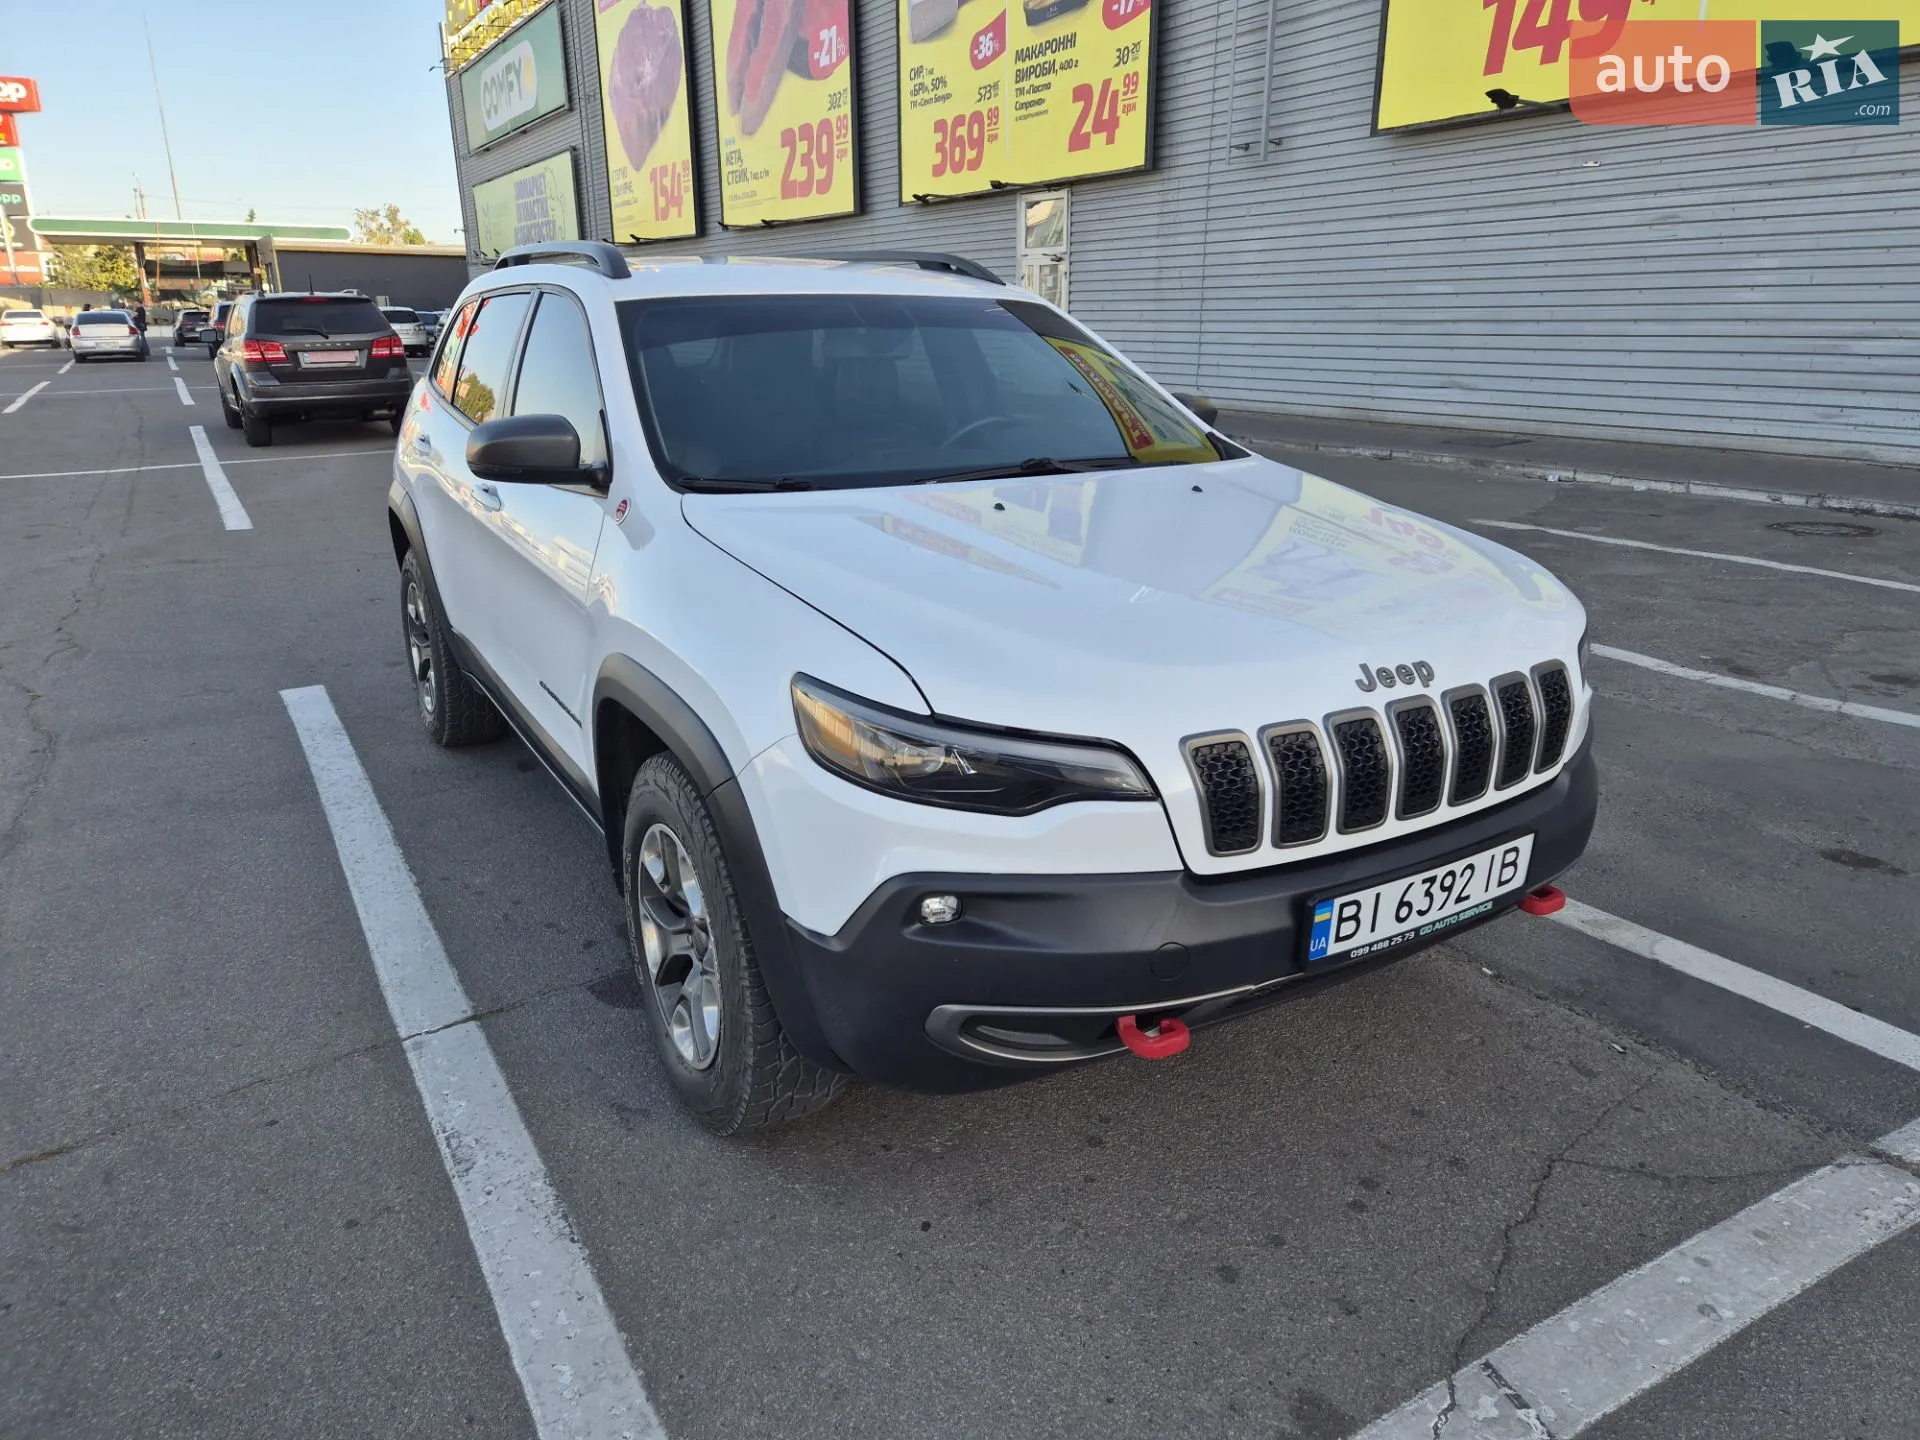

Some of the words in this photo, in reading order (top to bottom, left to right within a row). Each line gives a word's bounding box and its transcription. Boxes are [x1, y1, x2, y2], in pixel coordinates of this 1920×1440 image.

[813, 24, 846, 67] -21%
[1014, 32, 1077, 64] МАКАРОННІ
[1113, 45, 1130, 68] 30
[1482, 0, 1632, 76] 149
[483, 56, 522, 120] COMFY
[909, 65, 924, 81] СИР,
[931, 75, 948, 92] 50%
[1014, 58, 1058, 84] ВИРОБИ,
[1059, 58, 1073, 72] 400
[1068, 77, 1120, 152] 24
[1121, 71, 1139, 96] 99
[1121, 102, 1136, 116] грн
[780, 117, 835, 201] 239
[835, 112, 849, 140] 99
[931, 110, 985, 178] 369
[986, 106, 999, 127] 99
[649, 162, 684, 222] 154
[1355, 660, 1435, 693] Jeep
[1334, 892, 1381, 944] BI
[1394, 862, 1475, 924] 6392
[1484, 846, 1520, 893] IB
[1310, 936, 1327, 951] UA
[1350, 946, 1369, 958] 099
[1370, 939, 1389, 952] 488
[1403, 931, 1415, 942] 73
[1433, 915, 1458, 931] AUTO
[1458, 901, 1493, 921] SERVICE
